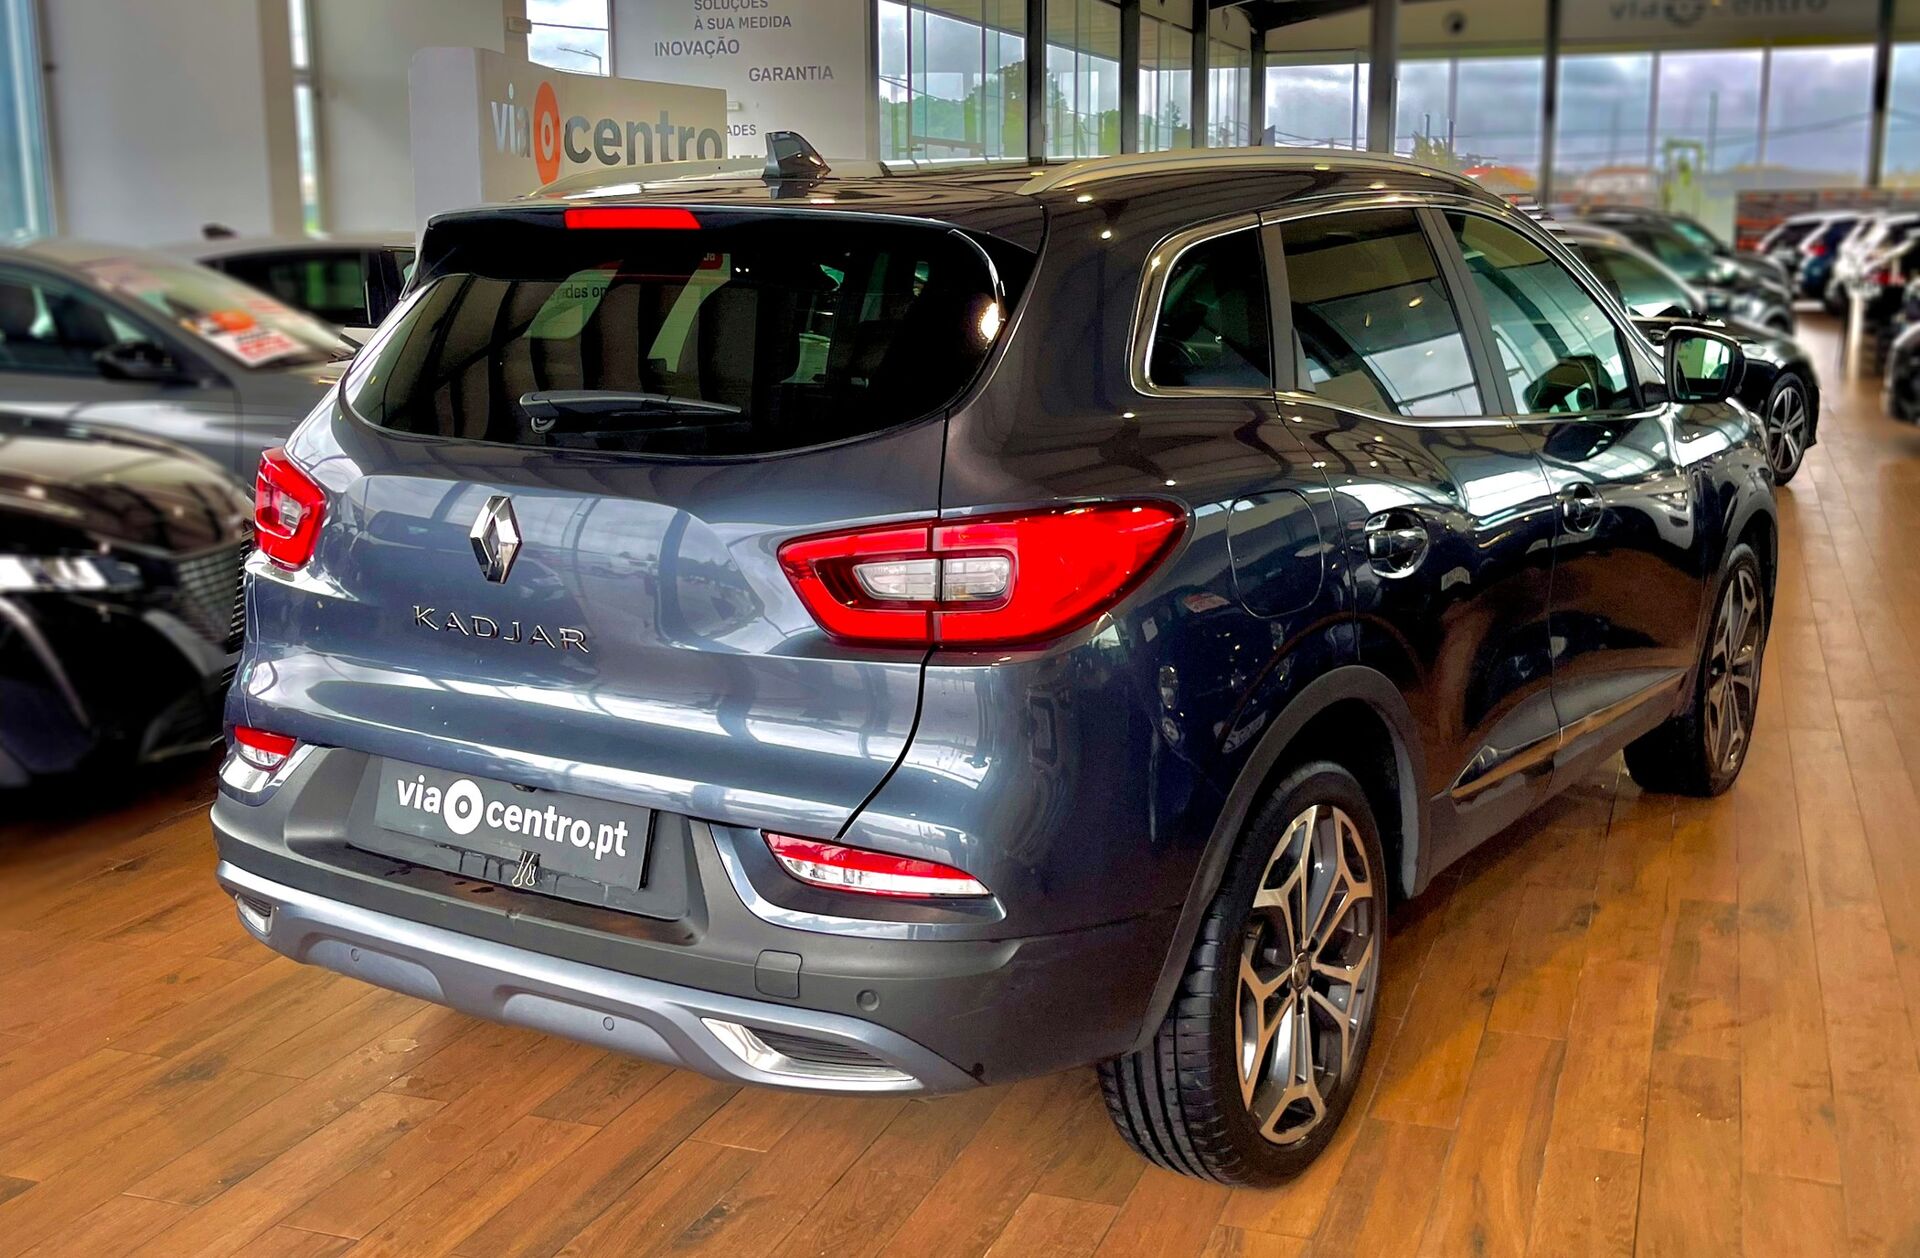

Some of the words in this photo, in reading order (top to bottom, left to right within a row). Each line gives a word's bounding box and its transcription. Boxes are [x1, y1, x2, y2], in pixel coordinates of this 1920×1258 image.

[694, 16, 703, 30] À
[707, 17, 735, 30] SUA
[739, 15, 792, 29] MEDIDA
[654, 37, 740, 58] INOVAÇÃO
[748, 66, 834, 82] GARANTIA
[413, 604, 589, 653] KADJAR
